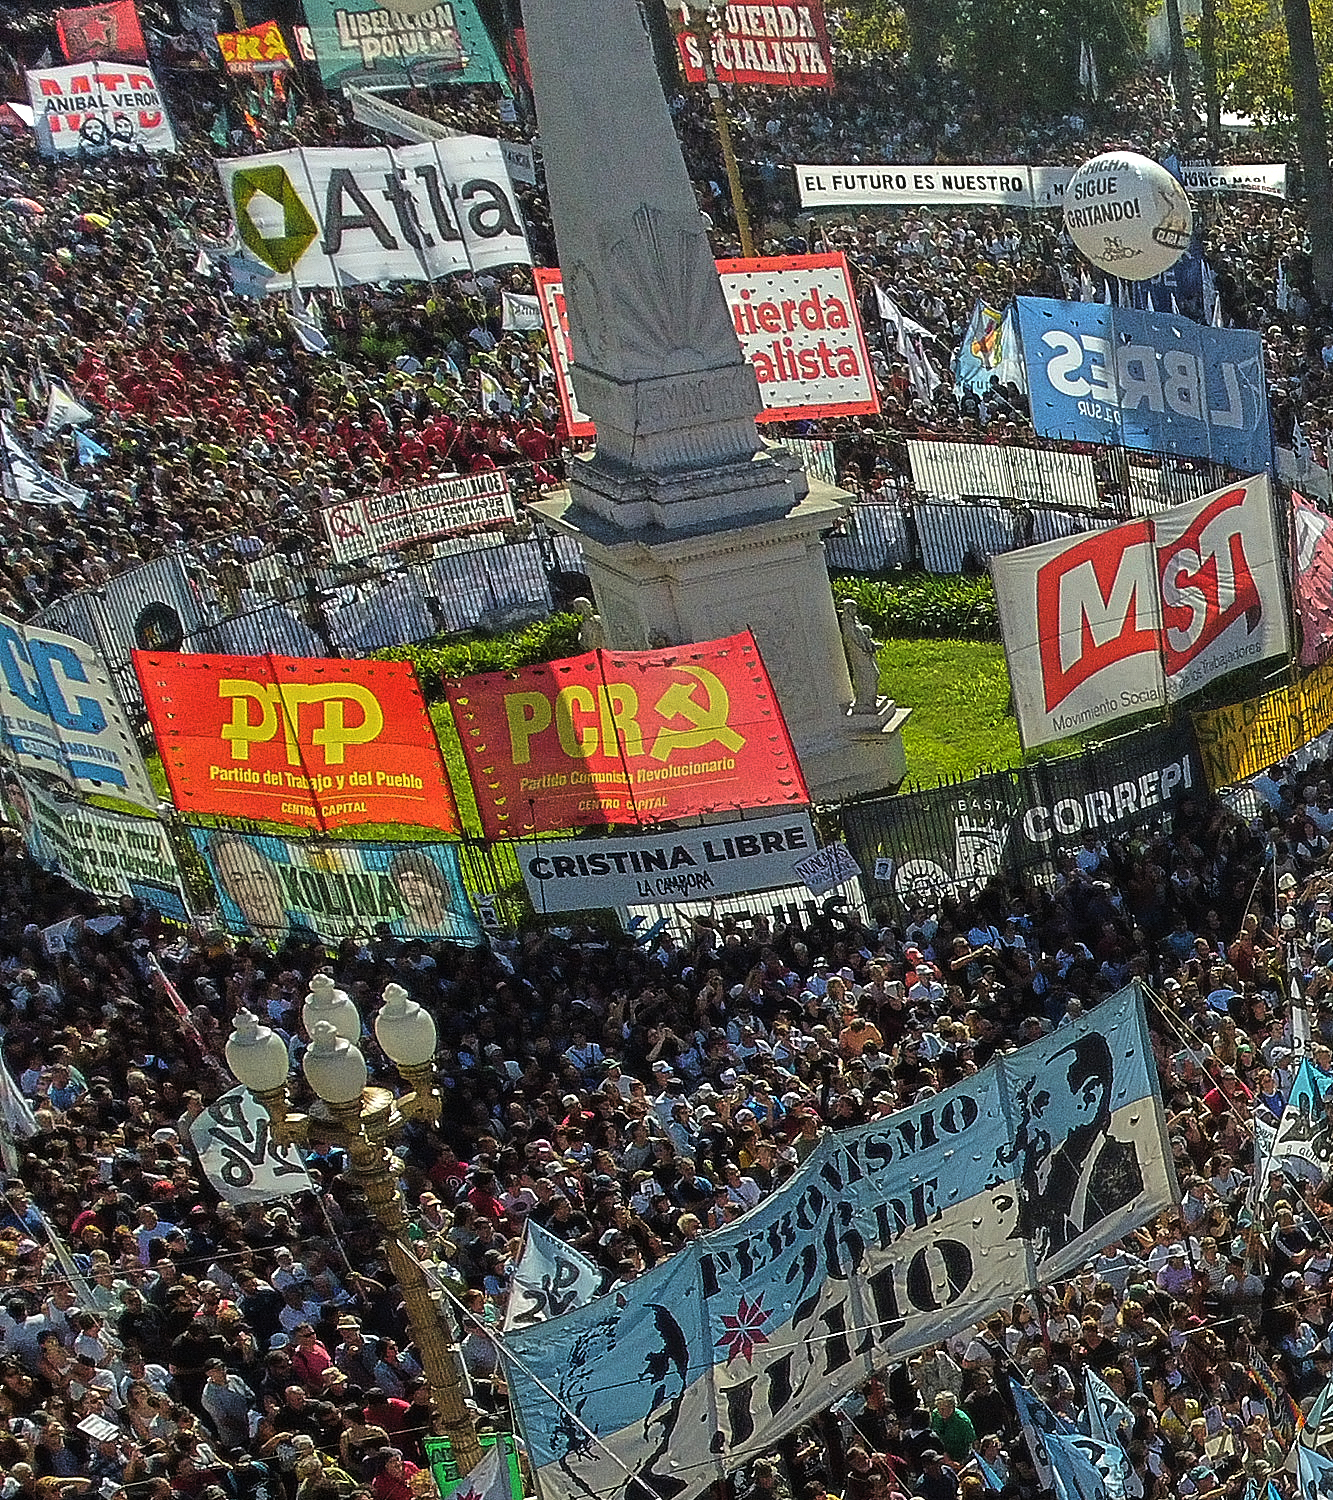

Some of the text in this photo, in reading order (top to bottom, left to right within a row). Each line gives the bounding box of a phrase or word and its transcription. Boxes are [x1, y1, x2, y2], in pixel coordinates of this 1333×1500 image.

[684, 35, 828, 74] SCIALISTA
[805, 174, 1023, 192] EL FUTURO ES NUESTRO
[1074, 177, 1118, 201] SIGUE
[1066, 197, 1142, 229] GRITANDO!
[1059, 506, 1245, 674] MST
[1052, 697, 1118, 732] Movimiento
[1201, 640, 1263, 677] Trabajadores
[219, 678, 385, 766] PTP
[504, 683, 641, 766] PCR
[210, 764, 264, 787] Partido
[265, 768, 284, 787] del
[287, 769, 333, 793] Trabajo
[348, 771, 370, 790] del
[374, 772, 423, 792] Pueblo
[519, 754, 737, 794] Partido Comunista Revolucionario
[1022, 752, 1194, 845] CORREPI
[280, 799, 368, 817] CENTRO CAPITAL
[577, 794, 668, 813] CENTRO CAPITAL
[529, 825, 806, 881] CRISTINA LIBRE
[699, 1096, 979, 1299] PERONISMO
[875, 1177, 944, 1243] DE
[715, 1239, 975, 1455] JULIO
